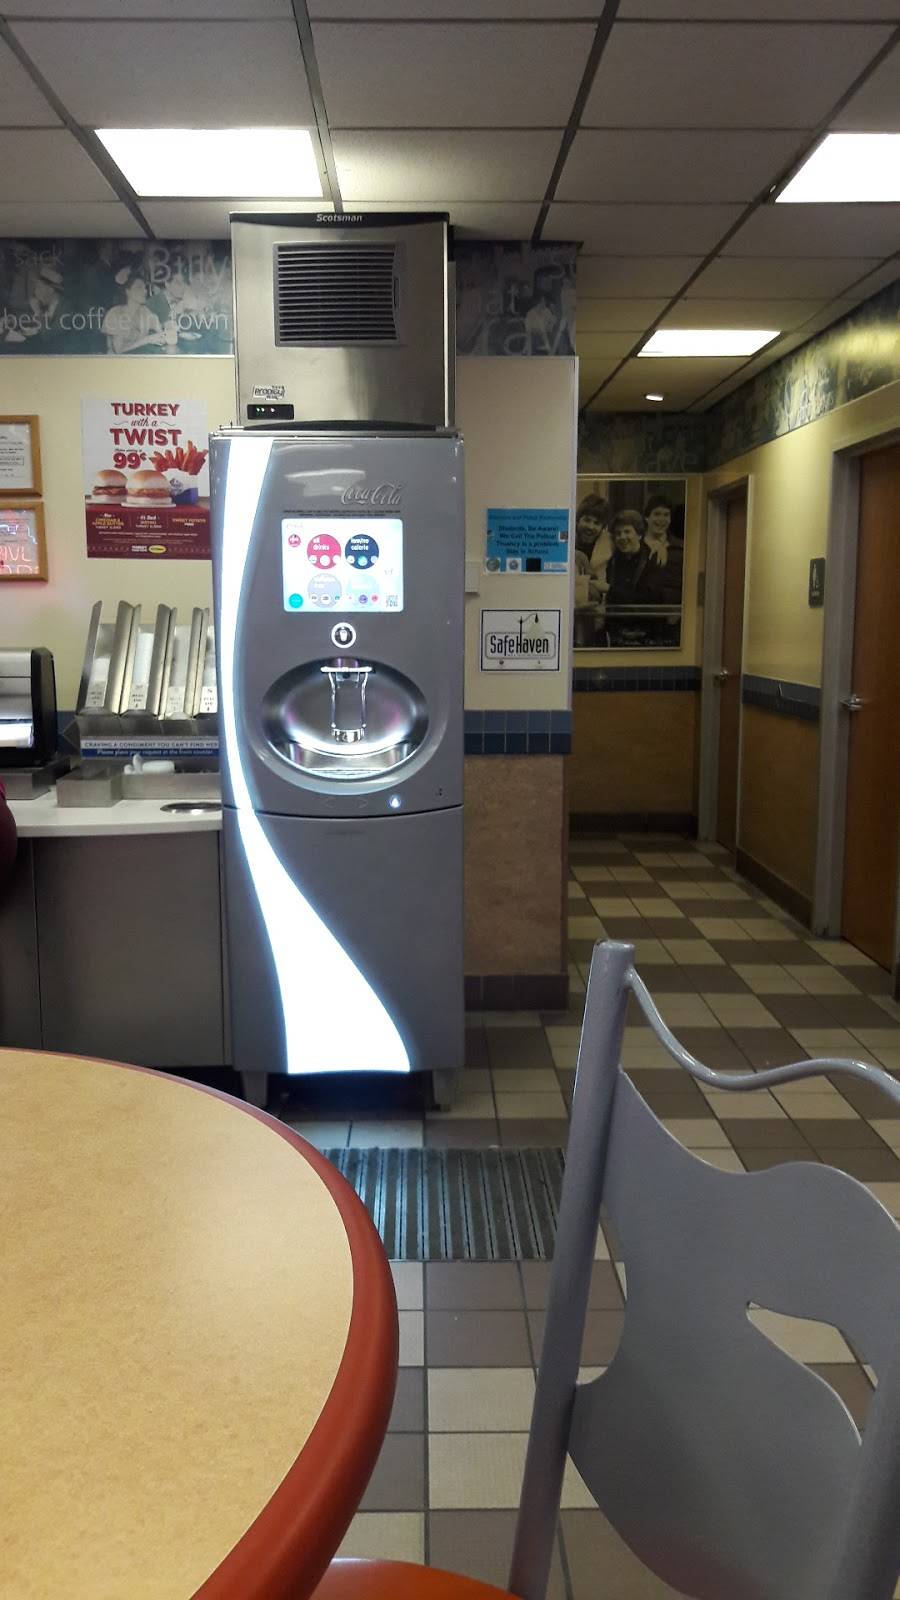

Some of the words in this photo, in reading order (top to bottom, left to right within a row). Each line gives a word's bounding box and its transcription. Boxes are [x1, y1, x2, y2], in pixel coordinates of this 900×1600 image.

[316, 213, 363, 222] Scotsman
[3, 307, 52, 331] best
[59, 306, 131, 331] coffee
[169, 308, 229, 331] town
[111, 403, 180, 416] TURKEY
[130, 417, 149, 427] with
[109, 428, 182, 447] TWIST
